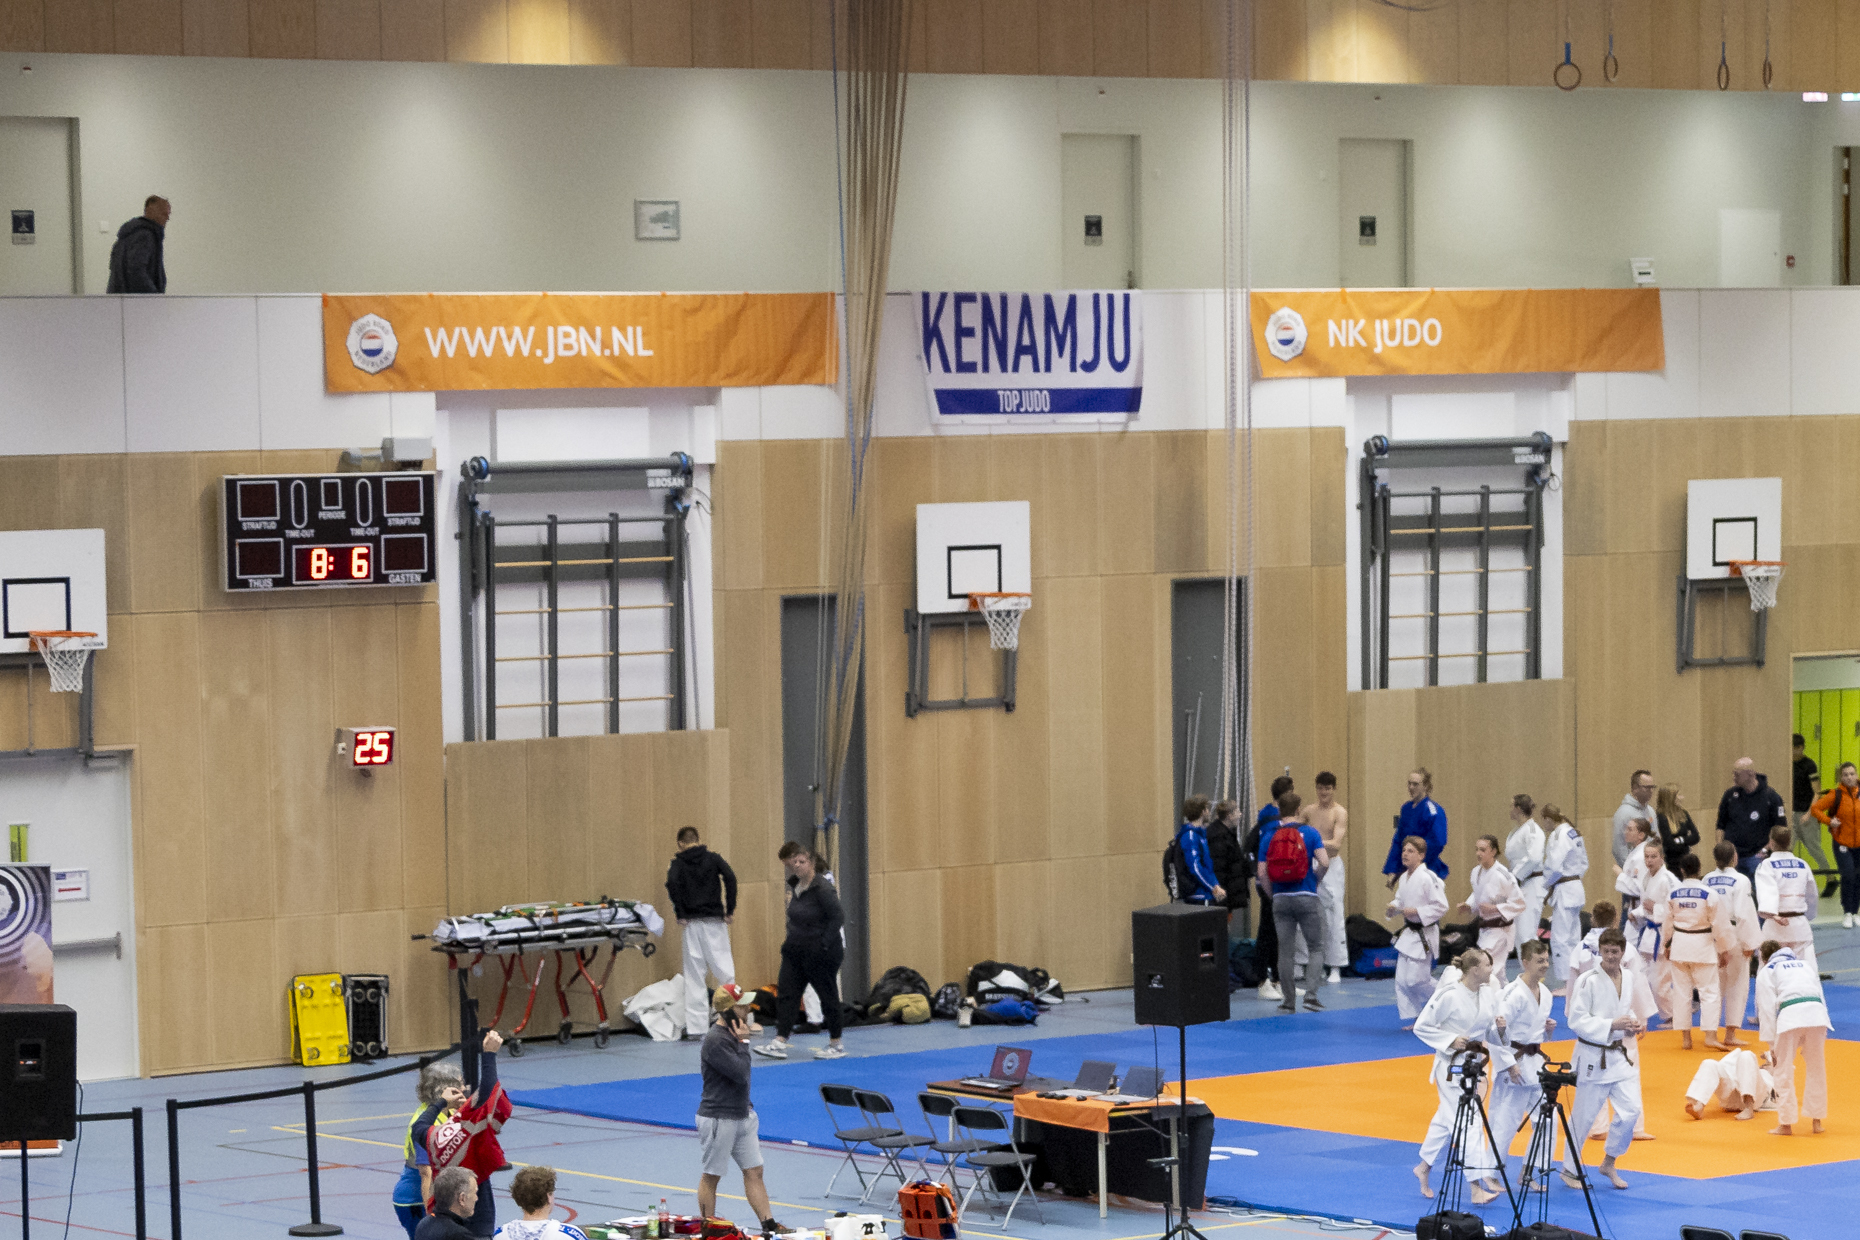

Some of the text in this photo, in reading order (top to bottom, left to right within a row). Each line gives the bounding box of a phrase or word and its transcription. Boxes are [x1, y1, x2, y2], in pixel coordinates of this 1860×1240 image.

[921, 291, 1131, 374] KENAMJU
[1327, 319, 1367, 347] NK
[1373, 318, 1442, 354] JUDO
[424, 325, 654, 365] WWW.JBN.NL
[318, 511, 346, 520] PERIODE
[248, 578, 273, 588] THUIS
[388, 574, 421, 584] GASTEN
[354, 732, 391, 764] 25
[1782, 871, 1799, 879] NED
[1679, 901, 1697, 909] NED
[1782, 961, 1804, 970] NED
[439, 1130, 467, 1163] DOCTOR
